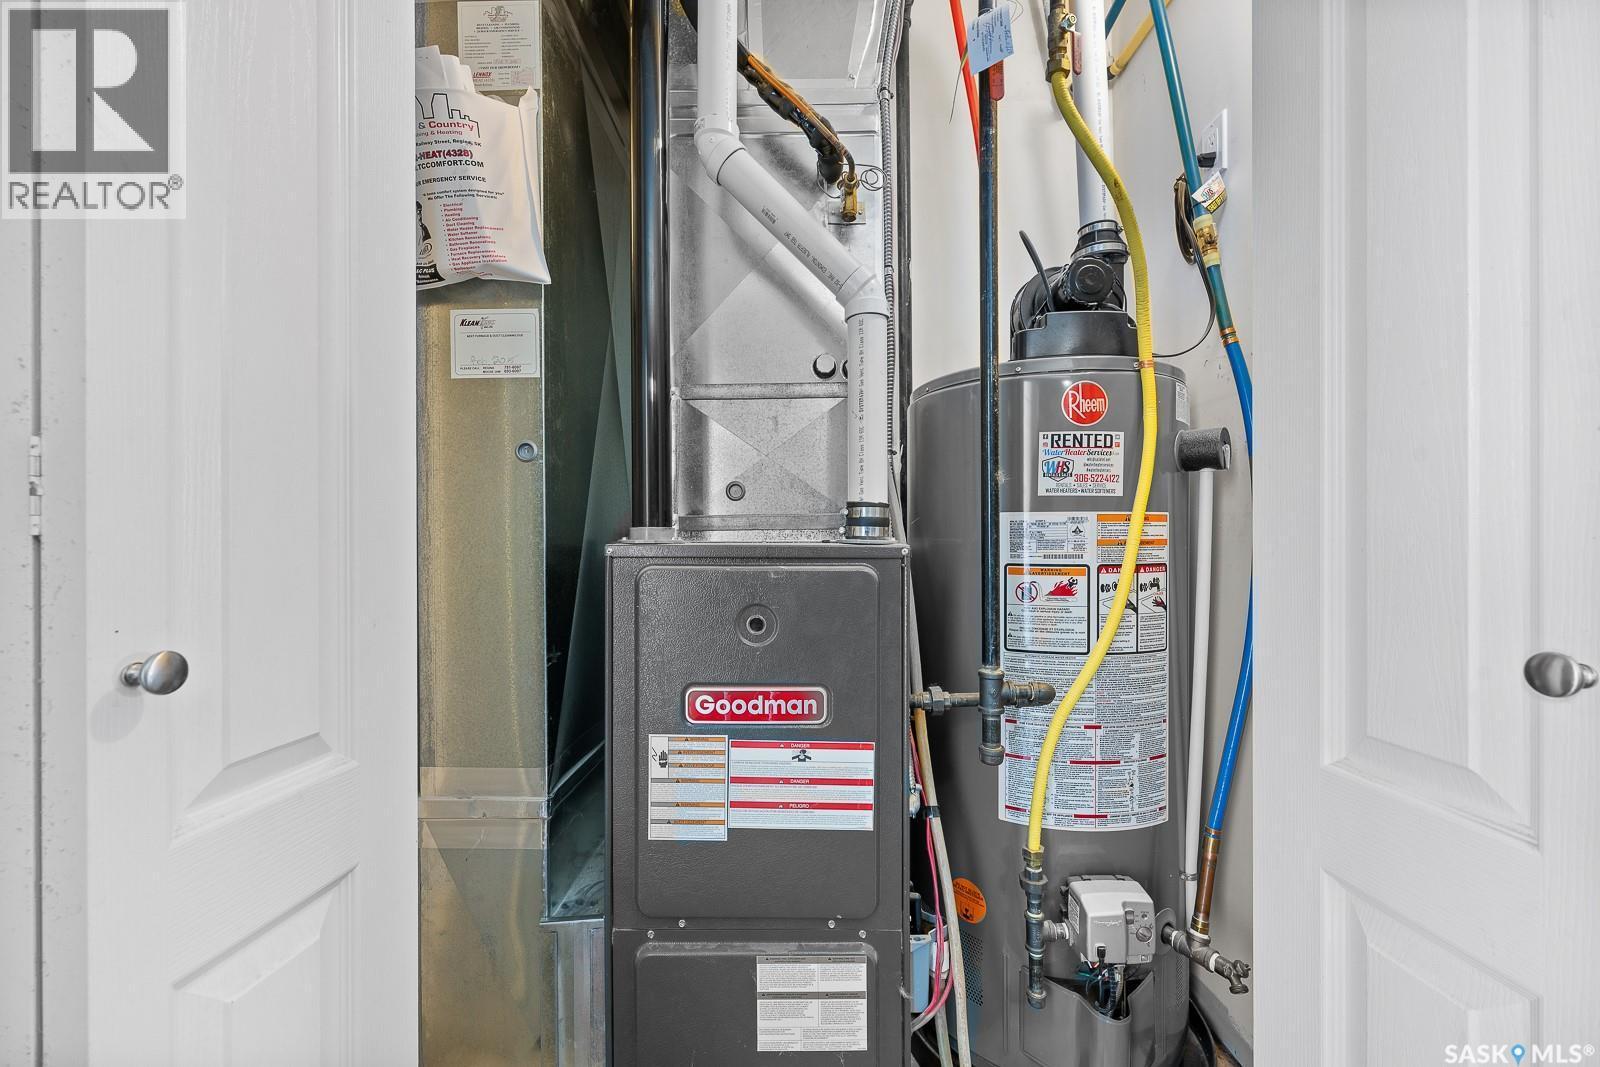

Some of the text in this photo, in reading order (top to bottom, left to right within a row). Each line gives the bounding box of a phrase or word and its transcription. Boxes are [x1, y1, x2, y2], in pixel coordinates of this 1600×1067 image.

[418, 121, 474, 131] & Country
[422, 176, 457, 185] EMERGENCY
[459, 318, 480, 327] KLEAN
[1067, 383, 1105, 419] Rheem
[1051, 433, 1114, 448] RENTED
[1044, 460, 1071, 474] WHS
[695, 694, 817, 715] Goodman
